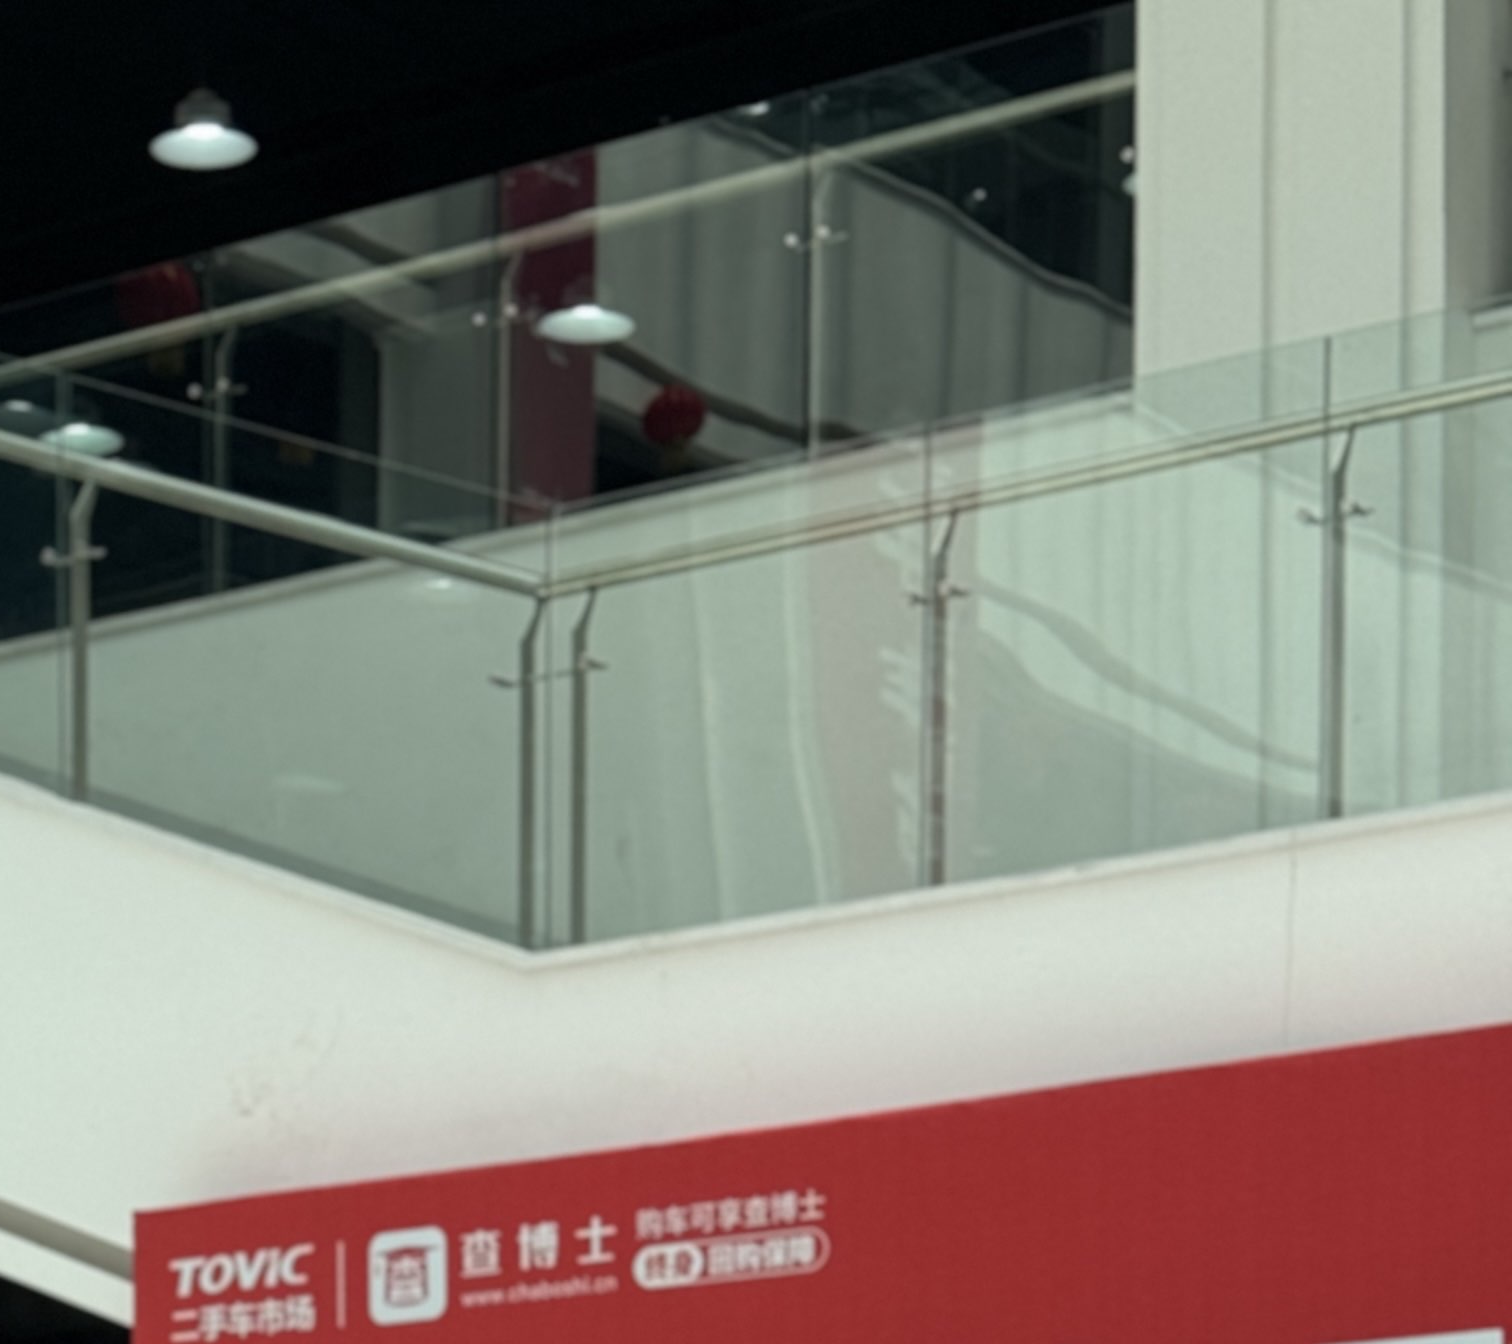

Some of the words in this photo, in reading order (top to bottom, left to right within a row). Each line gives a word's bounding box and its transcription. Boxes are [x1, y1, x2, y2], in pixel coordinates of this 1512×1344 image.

[460, 1214, 618, 1279] 查博士
[168, 1292, 317, 1344] 二手车市场
